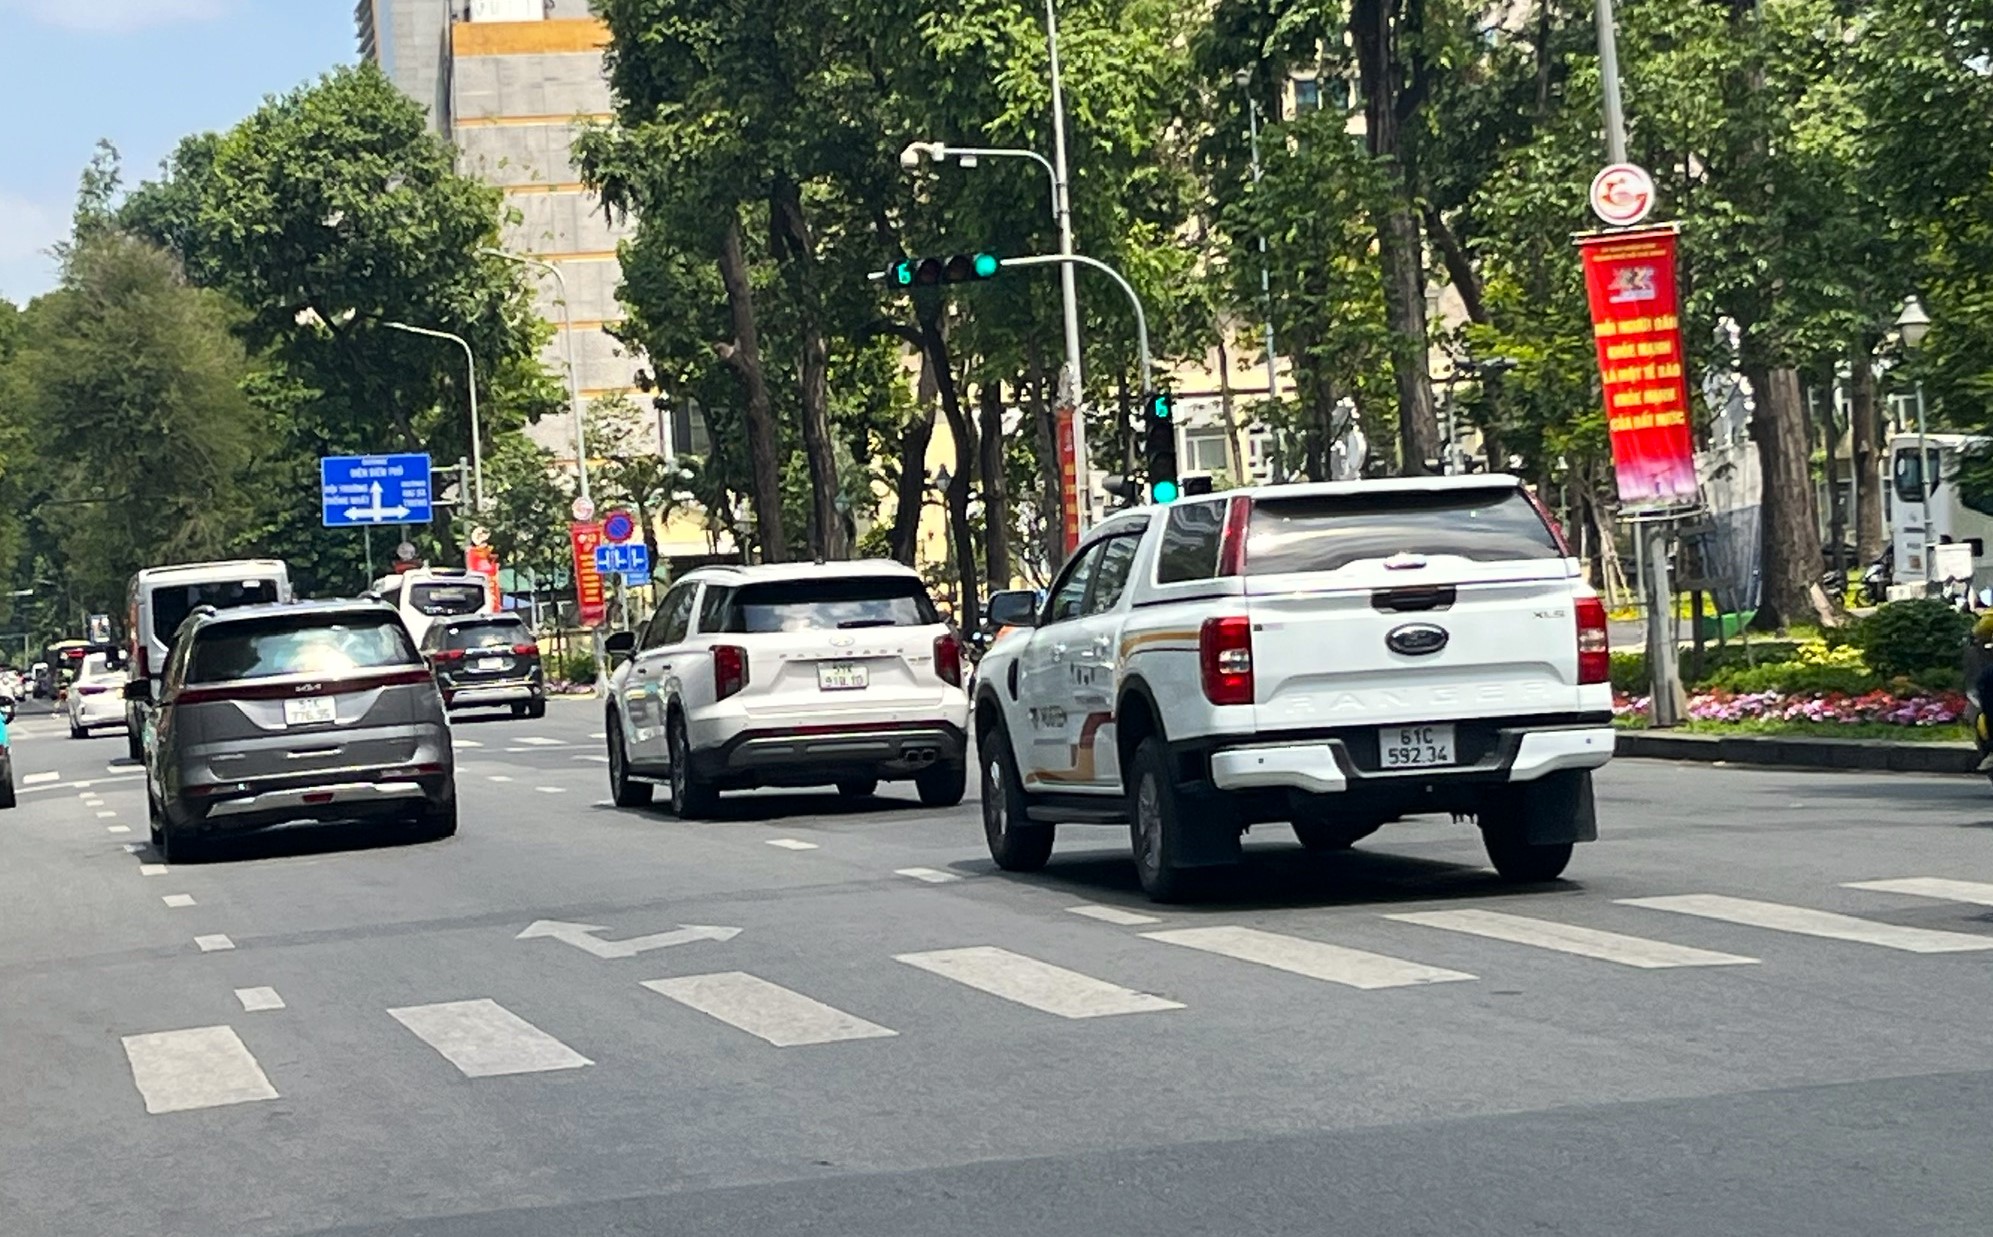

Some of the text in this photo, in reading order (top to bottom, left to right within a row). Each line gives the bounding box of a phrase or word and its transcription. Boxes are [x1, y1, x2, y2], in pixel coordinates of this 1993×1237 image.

[898, 263, 911, 284] 6
[1155, 397, 1168, 417] 6
[1284, 681, 1550, 714] RANGER
[1400, 727, 1433, 745] 61C
[1388, 745, 1448, 765] 592.34
